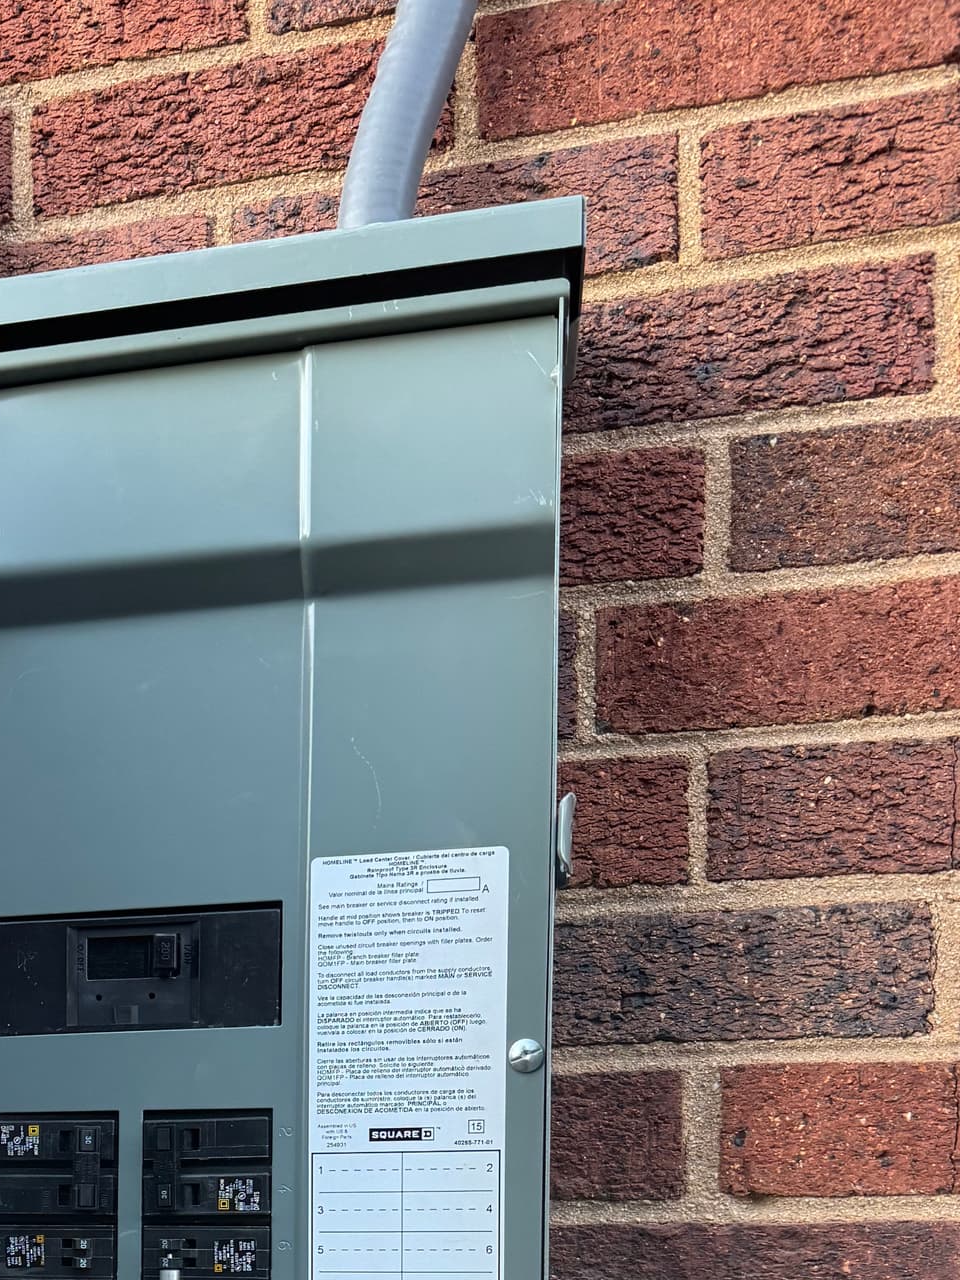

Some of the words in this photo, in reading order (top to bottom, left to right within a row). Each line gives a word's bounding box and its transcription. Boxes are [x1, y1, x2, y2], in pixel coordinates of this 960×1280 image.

[482, 884, 489, 892] A
[159, 941, 171, 961] 200
[471, 1122, 481, 1130] 15
[371, 1130, 419, 1138] SQUARE
[486, 1164, 493, 1172] 2
[318, 1206, 324, 1214] 3
[80, 1240, 87, 1249] 20
[162, 1240, 168, 1249] 20
[318, 1246, 324, 1254] 5
[486, 1246, 492, 1254] 6
[80, 1259, 87, 1268] 20
[162, 1258, 168, 1268] 20
